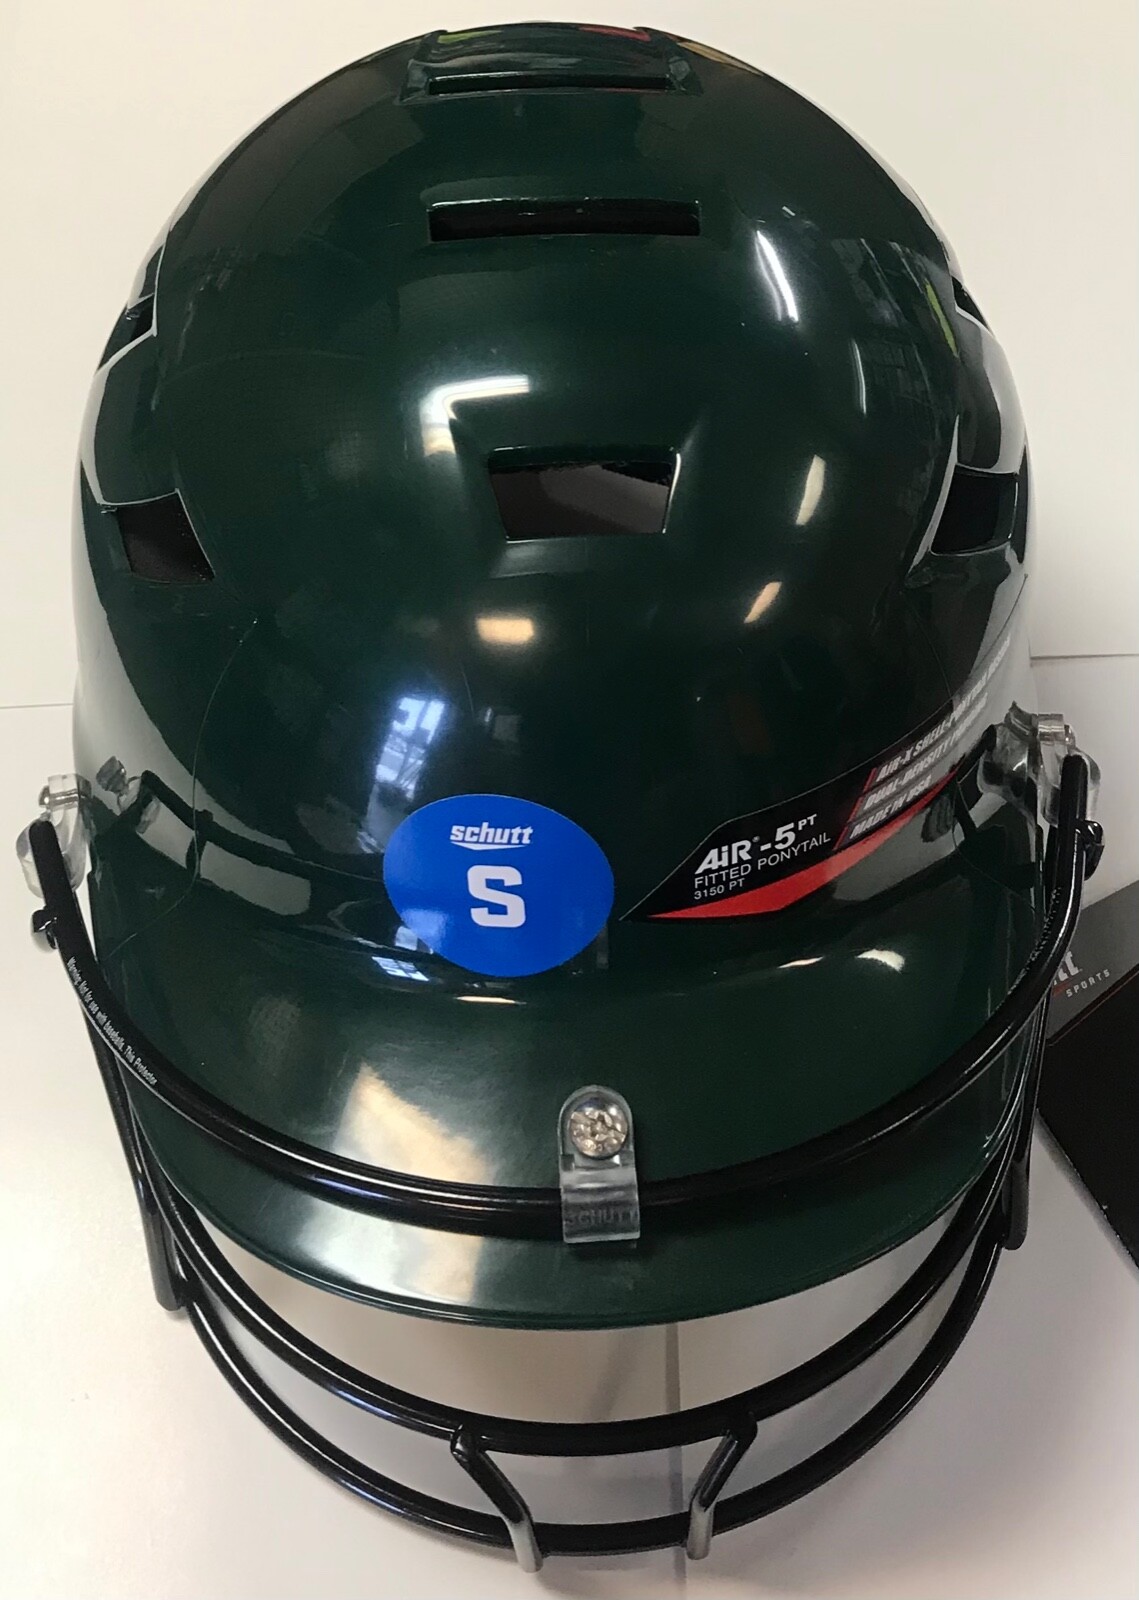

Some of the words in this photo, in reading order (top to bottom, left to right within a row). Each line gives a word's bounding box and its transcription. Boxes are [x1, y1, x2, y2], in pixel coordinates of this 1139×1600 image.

[449, 822, 534, 844] schutt
[850, 804, 892, 839] MADE
[694, 863, 752, 889] FITTED
[757, 832, 831, 871] PONYTAIL
[467, 865, 526, 928] S
[694, 884, 725, 900] 3150
[729, 877, 746, 891] PT
[1065, 969, 1110, 998] SPORTS
